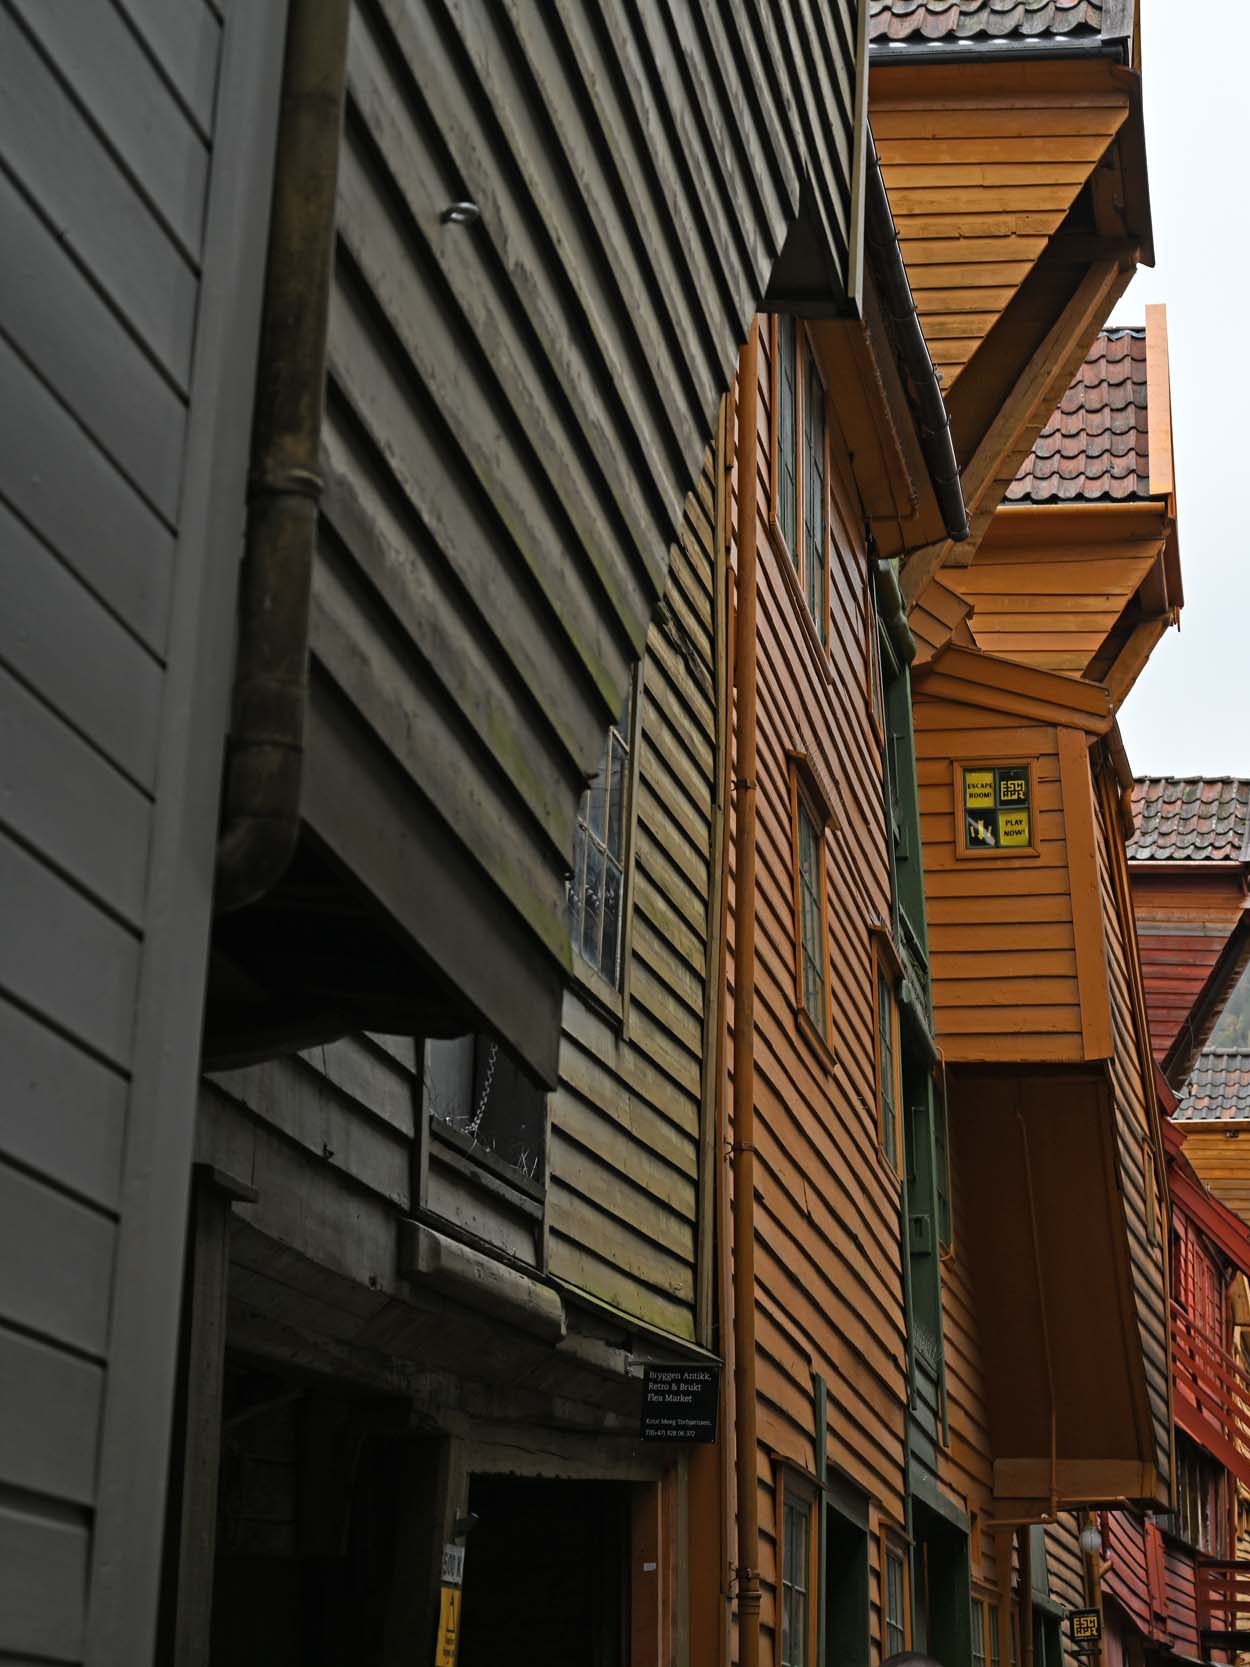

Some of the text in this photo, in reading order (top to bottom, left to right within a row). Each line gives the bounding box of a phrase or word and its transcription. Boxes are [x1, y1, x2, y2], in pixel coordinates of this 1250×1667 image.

[1004, 829, 1025, 837] NOW!
[648, 1382, 702, 1391] Retro & Brukt
[647, 1393, 693, 1402] Flea Market
